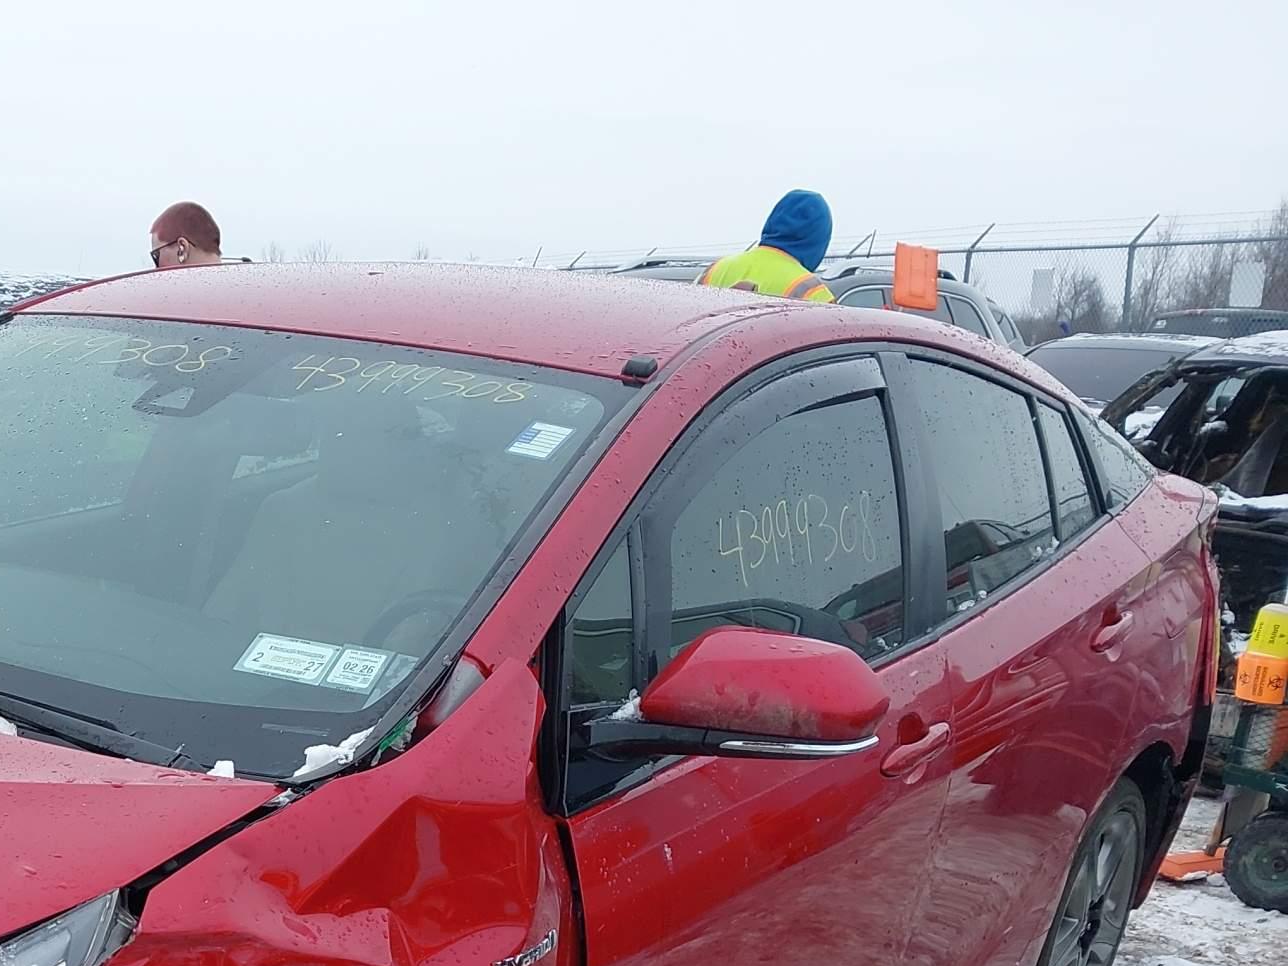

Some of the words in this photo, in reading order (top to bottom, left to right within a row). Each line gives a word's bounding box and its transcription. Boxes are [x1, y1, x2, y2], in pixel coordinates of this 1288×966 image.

[291, 354, 534, 403] 43999308
[718, 490, 877, 587] 43999308
[304, 661, 325, 673] 27
[342, 661, 358, 672] 02
[359, 663, 376, 674] 26
